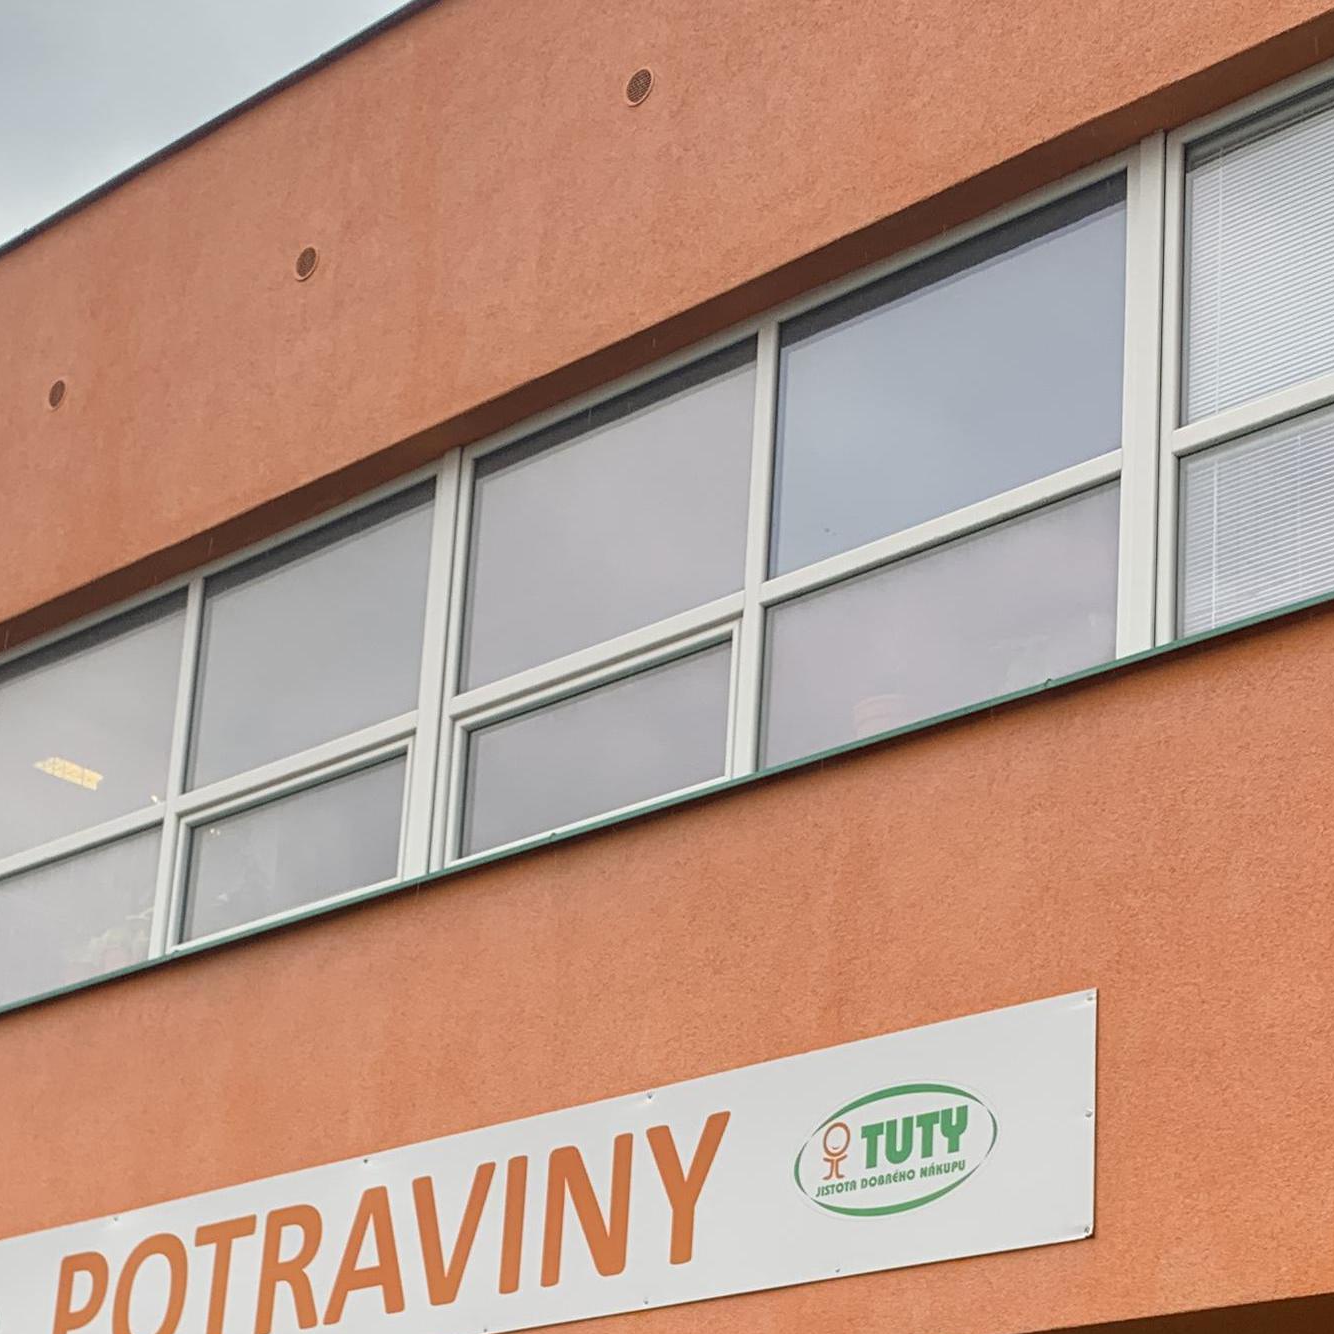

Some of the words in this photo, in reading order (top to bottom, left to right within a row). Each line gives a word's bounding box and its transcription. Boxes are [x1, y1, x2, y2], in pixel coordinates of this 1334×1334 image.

[860, 1104, 969, 1170] TUTY
[815, 1180, 857, 1198] JISTOTA
[860, 1169, 916, 1190] DOBRÉHO
[919, 1159, 967, 1179] NÁKUPU
